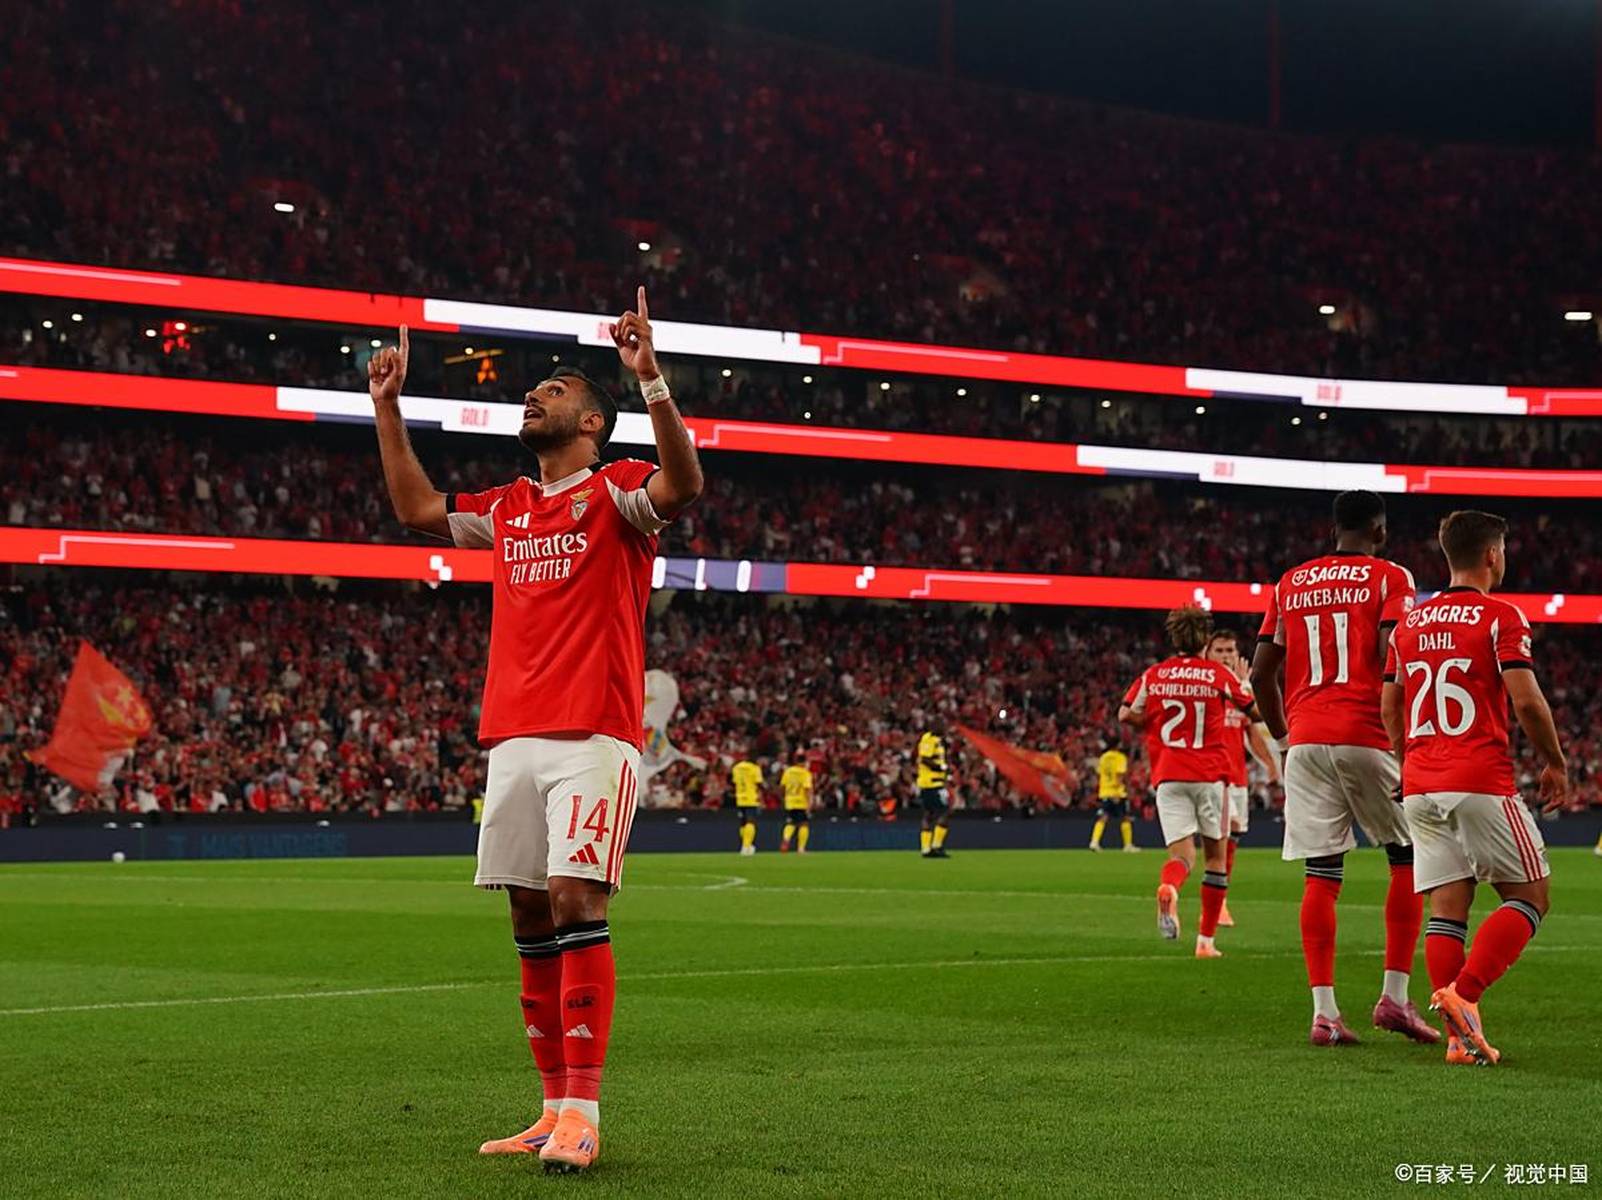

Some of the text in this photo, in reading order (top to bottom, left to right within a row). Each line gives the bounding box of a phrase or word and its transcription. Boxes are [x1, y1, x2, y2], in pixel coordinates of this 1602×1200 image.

[503, 533, 588, 562] Emirates
[510, 558, 571, 585] FLY BETTER
[1306, 565, 1372, 585] SAGRES
[1285, 587, 1370, 611] LUKEBAKIO
[1418, 605, 1484, 627] SAGRES
[1303, 612, 1349, 687] 11
[1418, 631, 1456, 652] DAHL
[1169, 667, 1216, 683] SAGRES
[1405, 658, 1476, 739] 26
[1160, 699, 1206, 749] 21
[566, 794, 610, 843] 14
